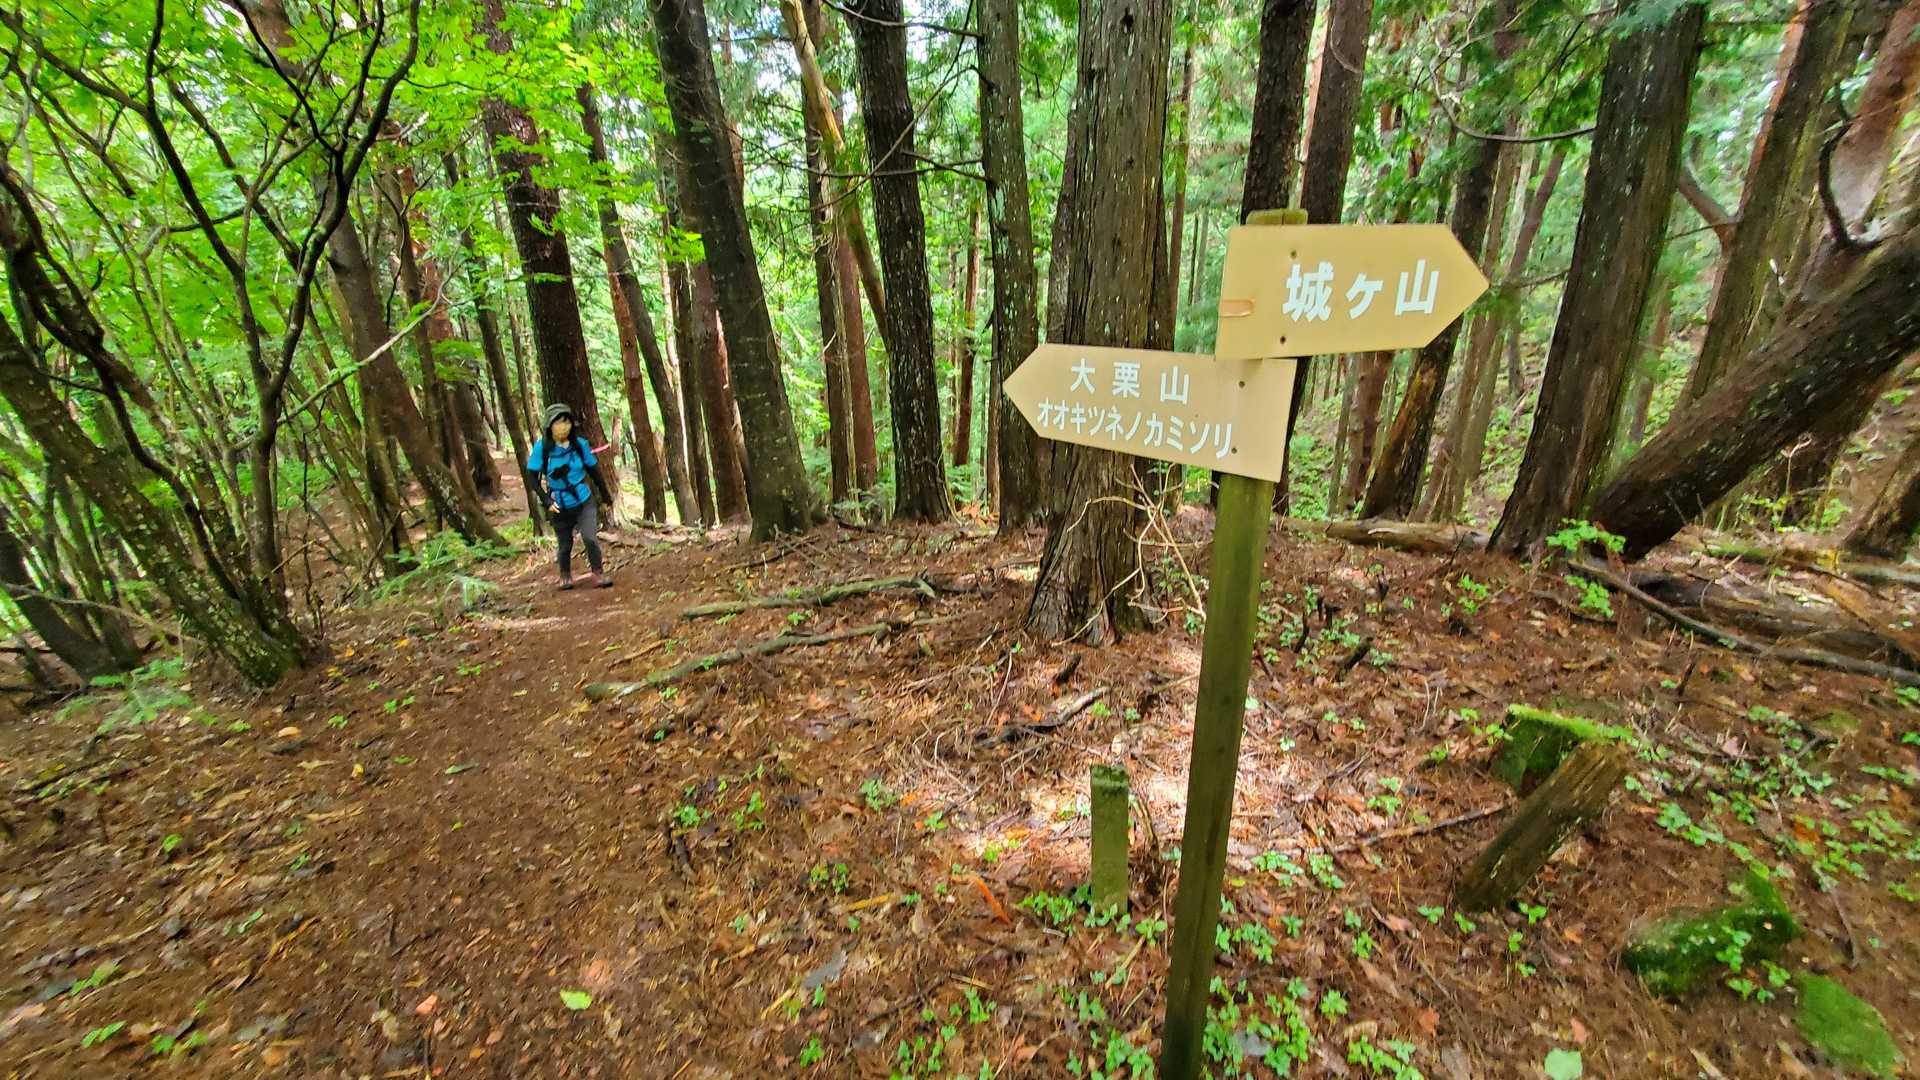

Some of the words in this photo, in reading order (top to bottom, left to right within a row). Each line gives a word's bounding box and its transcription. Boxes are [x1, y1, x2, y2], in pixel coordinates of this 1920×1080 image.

[1036, 398, 1233, 460] オオキツネノカミソリ
